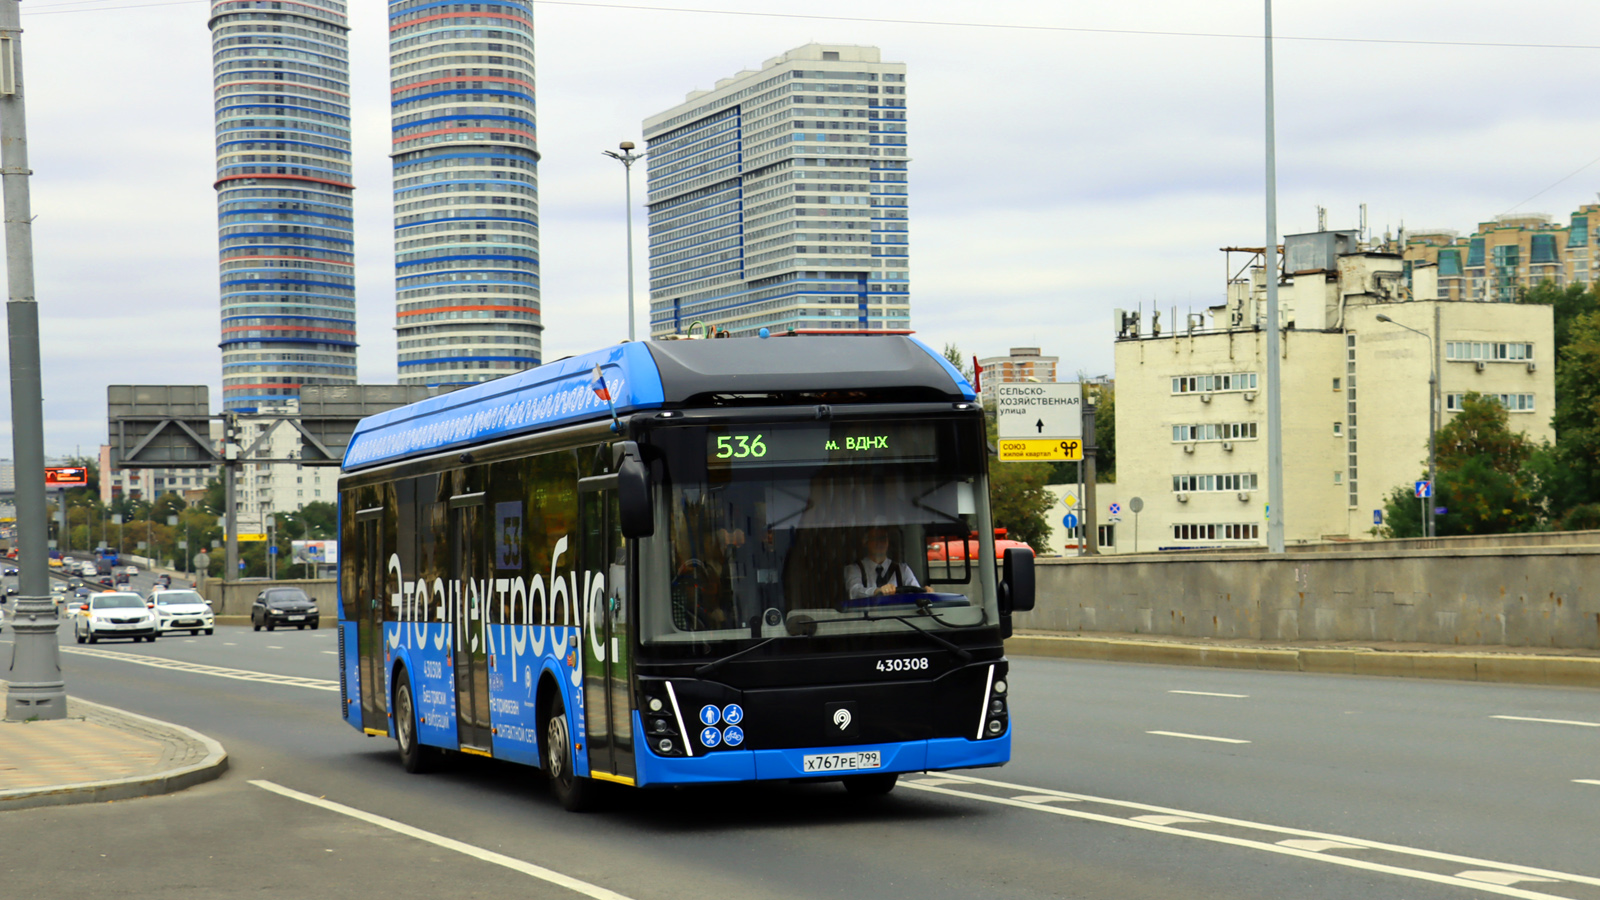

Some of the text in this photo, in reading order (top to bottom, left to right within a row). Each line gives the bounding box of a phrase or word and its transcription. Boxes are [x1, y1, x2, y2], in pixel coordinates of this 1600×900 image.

[999, 387, 1046, 396] СЕЛЬСКО-
[999, 396, 1080, 406] ХОЗЯЙСТВЕННАЯ
[999, 408, 1026, 416] улица
[716, 434, 767, 459] 536
[824, 435, 889, 451] м. ВДНХ
[388, 553, 428, 650] Это
[876, 657, 929, 672] 430308
[858, 752, 877, 763] 799
